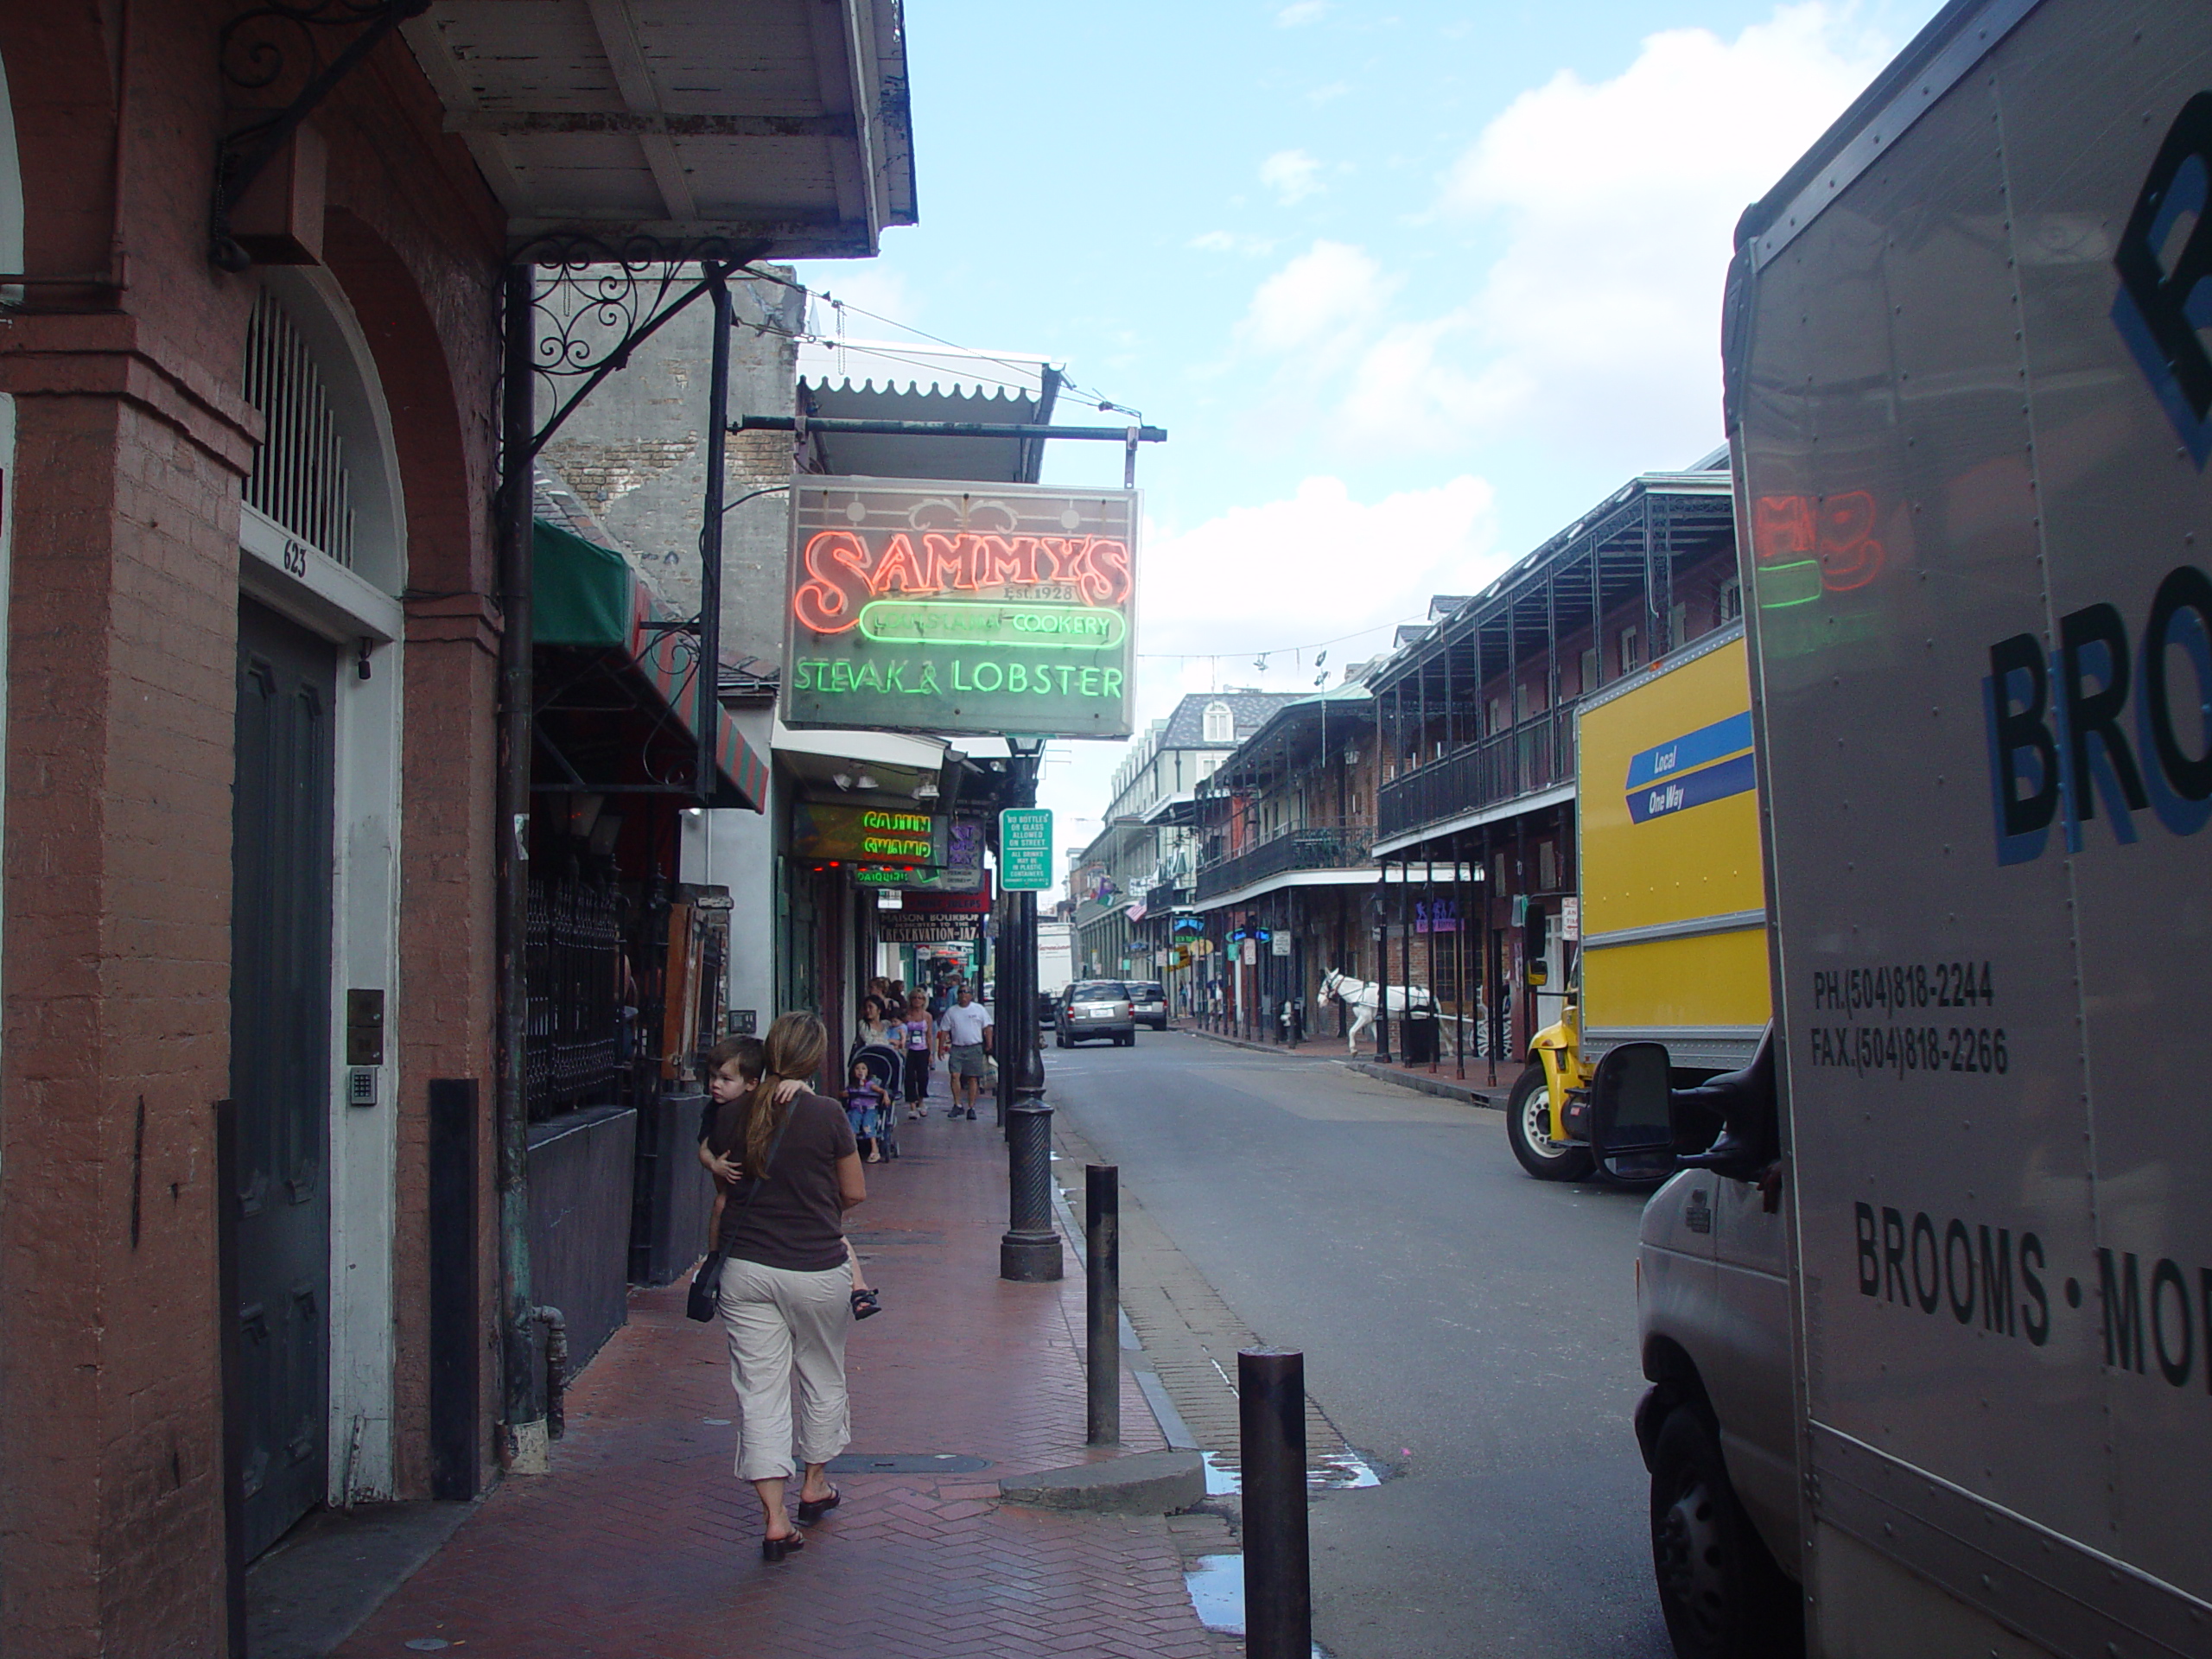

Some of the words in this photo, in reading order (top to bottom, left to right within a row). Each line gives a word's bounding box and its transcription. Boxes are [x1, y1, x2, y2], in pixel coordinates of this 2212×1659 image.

[284, 539, 306, 578] 623
[1012, 613, 1111, 635] COOKERY
[793, 656, 909, 694] STEAK
[952, 659, 1123, 698] LOBSTER
[1654, 745, 1677, 774] Local
[1649, 791, 1664, 814] One
[1666, 785, 1684, 810] Way
[864, 810, 931, 834] CAJUN
[864, 836, 931, 859] SWAMP
[1855, 1201, 2050, 1346] BROOMS
